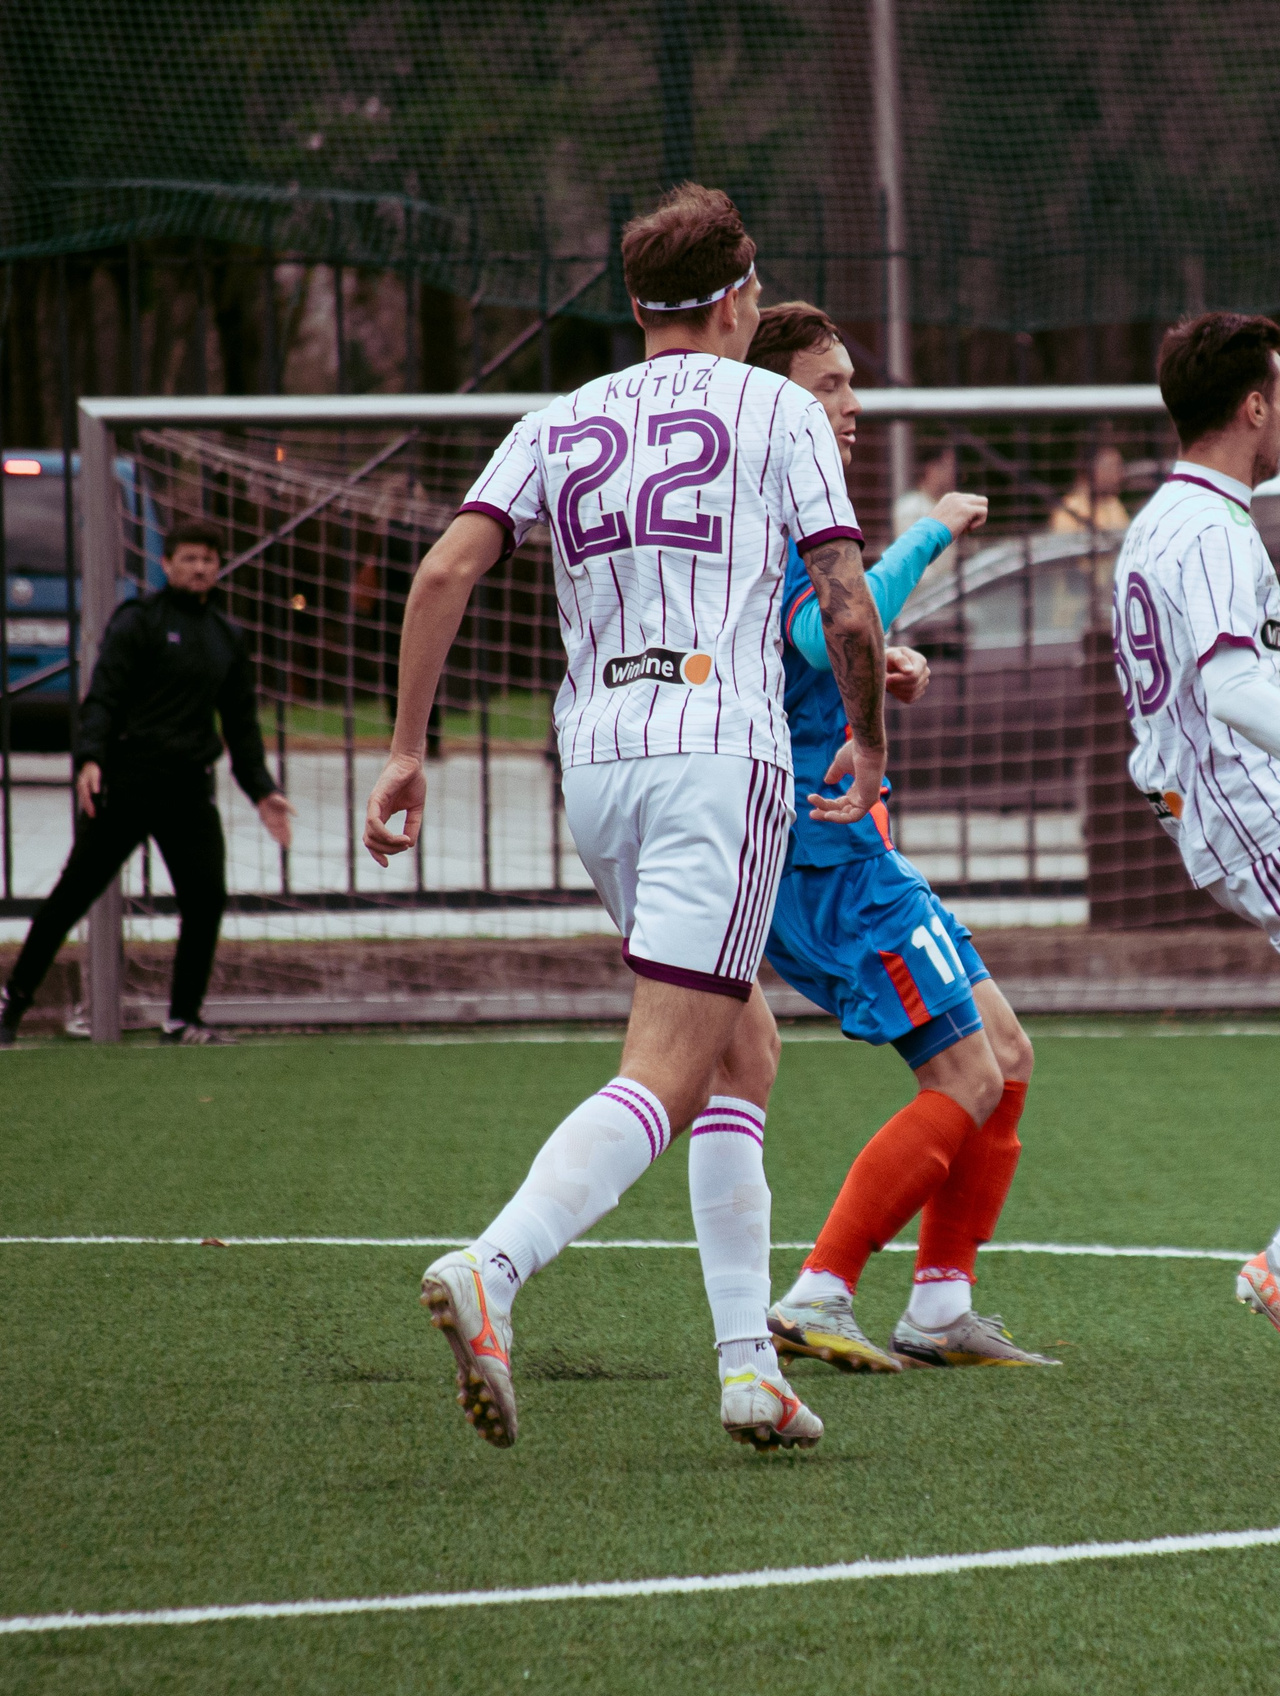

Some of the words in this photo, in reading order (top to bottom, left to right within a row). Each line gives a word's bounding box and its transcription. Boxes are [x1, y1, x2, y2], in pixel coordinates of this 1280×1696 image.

[605, 369, 711, 402] KUTUZ
[548, 409, 731, 567] 22
[911, 914, 966, 985] 11
